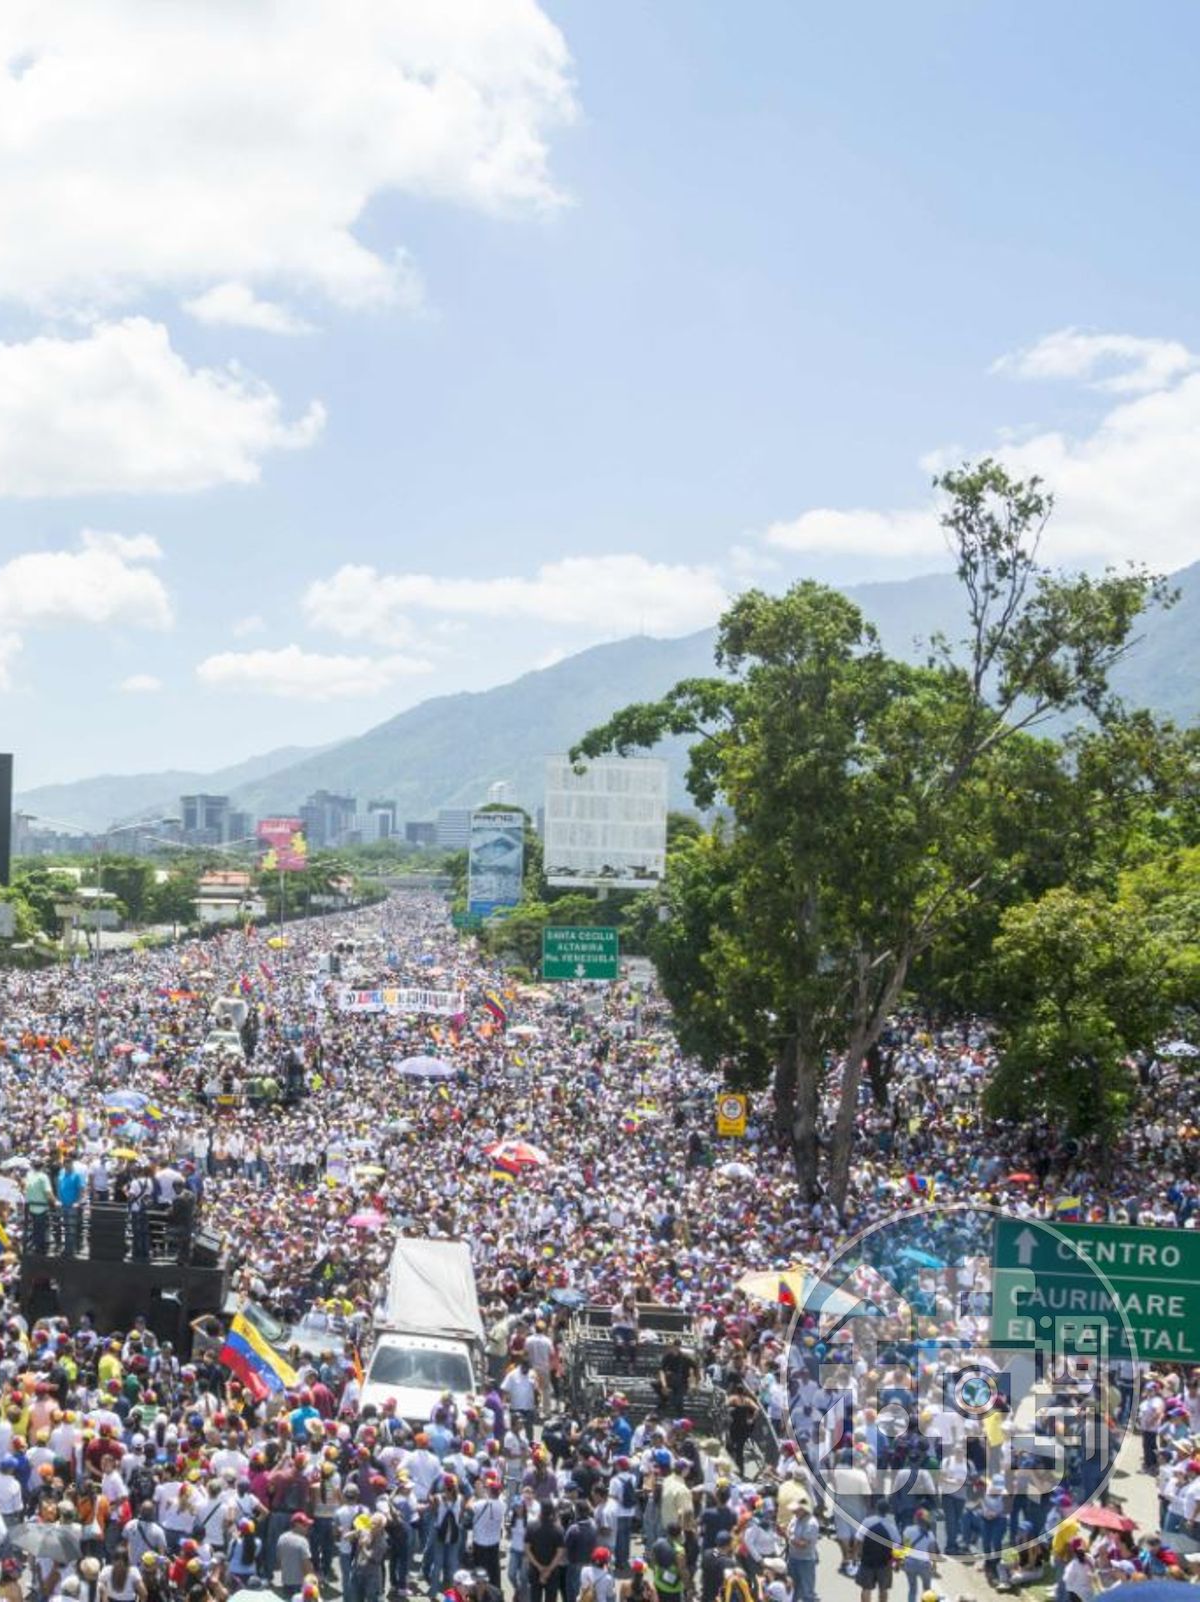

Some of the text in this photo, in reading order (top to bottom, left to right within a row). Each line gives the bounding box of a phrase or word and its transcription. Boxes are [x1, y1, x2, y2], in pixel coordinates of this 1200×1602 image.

[546, 930, 614, 941] SANTA CECILIA
[557, 943, 604, 952] ALTAMIRA
[561, 953, 616, 963] VENEZUELA
[1056, 1239, 1181, 1267] CENTRO
[1010, 1285, 1186, 1318] CAURIMARE
[1007, 1319, 1195, 1354] EL CAFETAL
